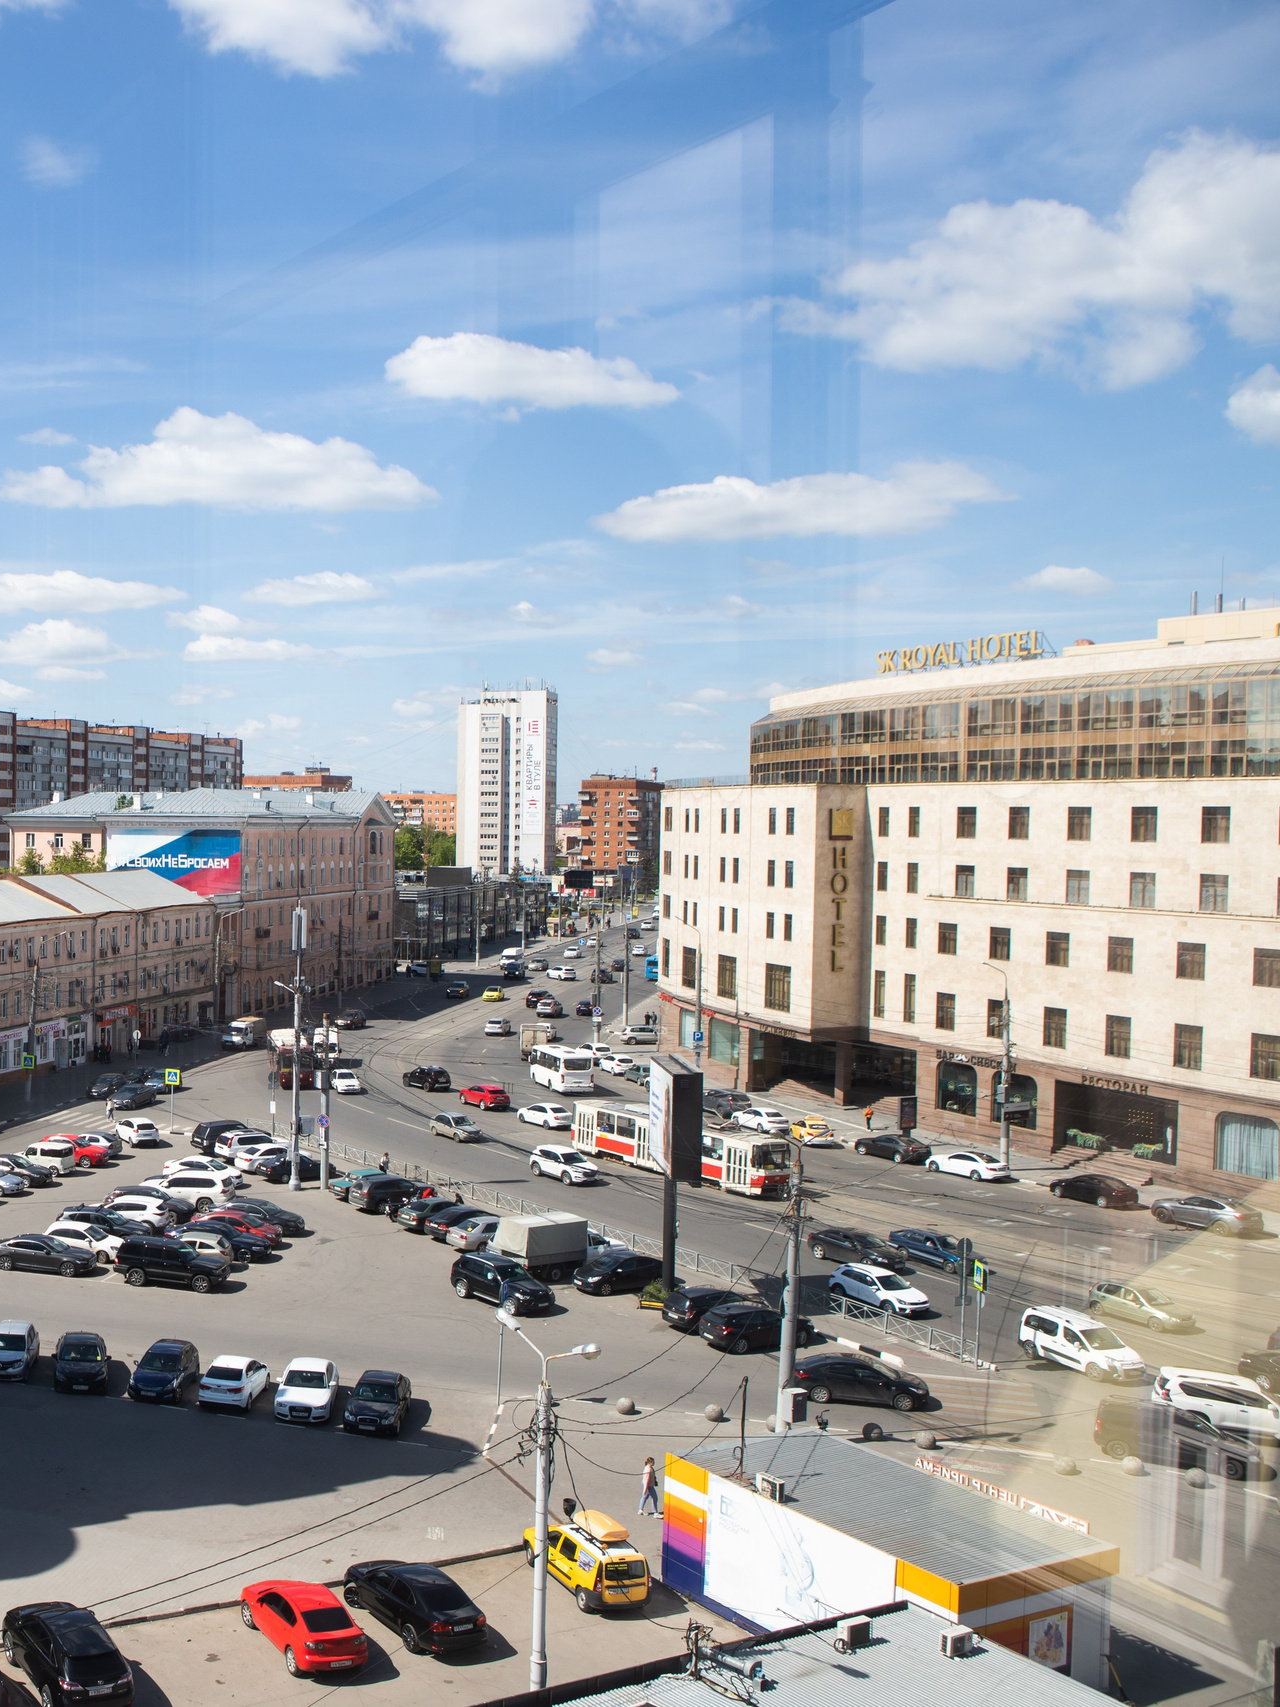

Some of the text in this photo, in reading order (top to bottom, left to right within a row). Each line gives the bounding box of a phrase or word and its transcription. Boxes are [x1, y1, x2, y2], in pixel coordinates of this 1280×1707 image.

[876, 630, 1044, 674] SK ROYAL HOTEL
[831, 847, 849, 972] HOTEL
[1081, 1075, 1148, 1095] РЕСТОРАН
